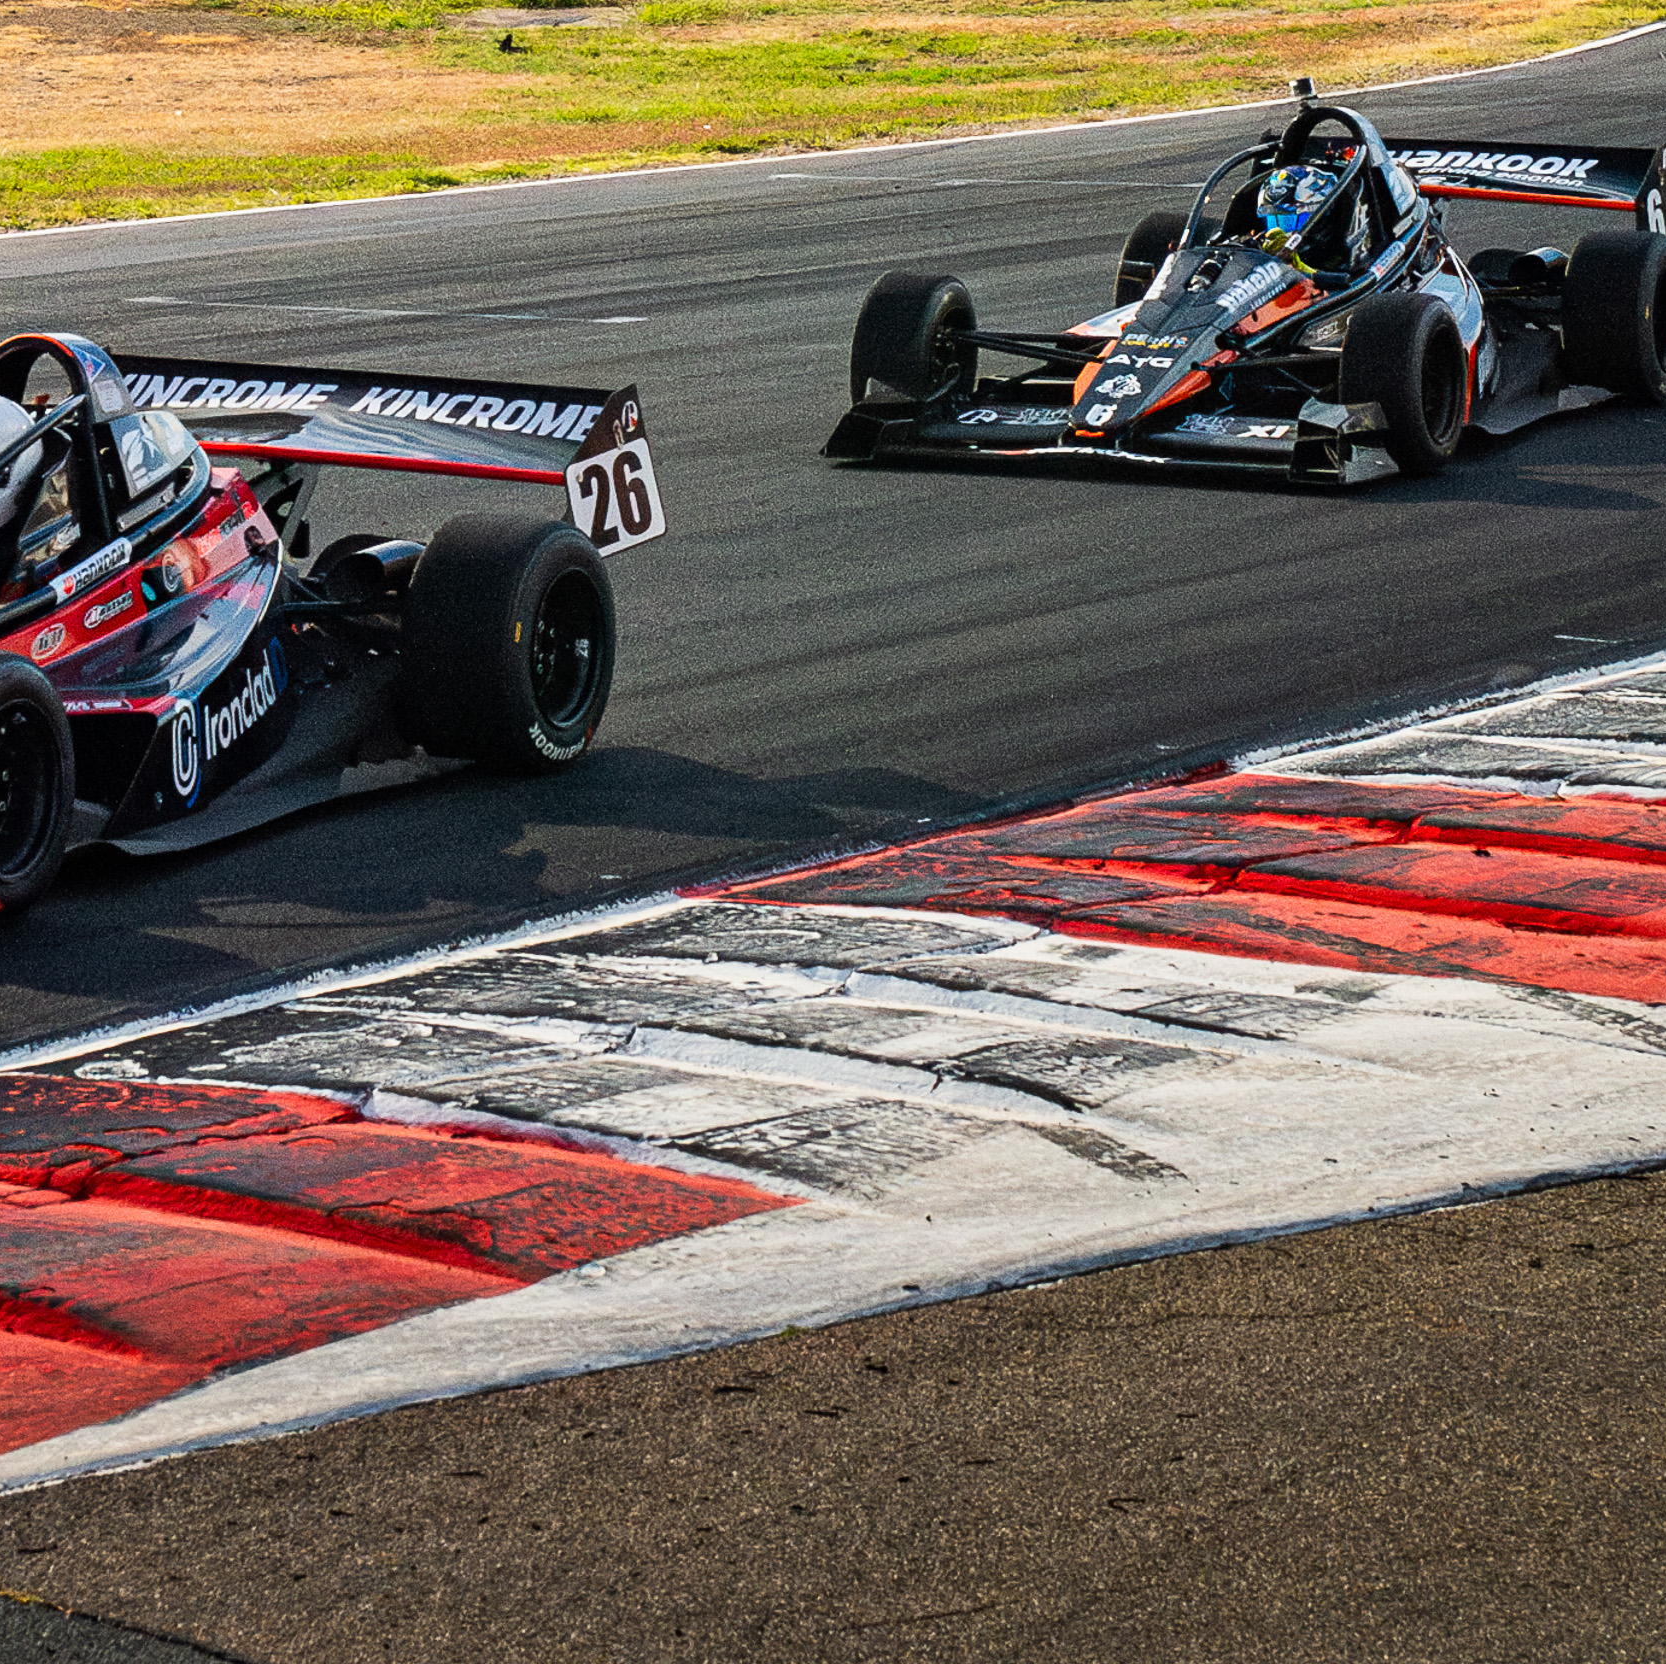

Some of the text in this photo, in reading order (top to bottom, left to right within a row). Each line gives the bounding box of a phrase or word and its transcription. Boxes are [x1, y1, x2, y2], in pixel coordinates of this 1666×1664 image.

[350, 386, 606, 442] KINCROME
[1085, 403, 1118, 426] 6
[578, 451, 652, 549] 26
[204, 649, 277, 760] Ironclad
